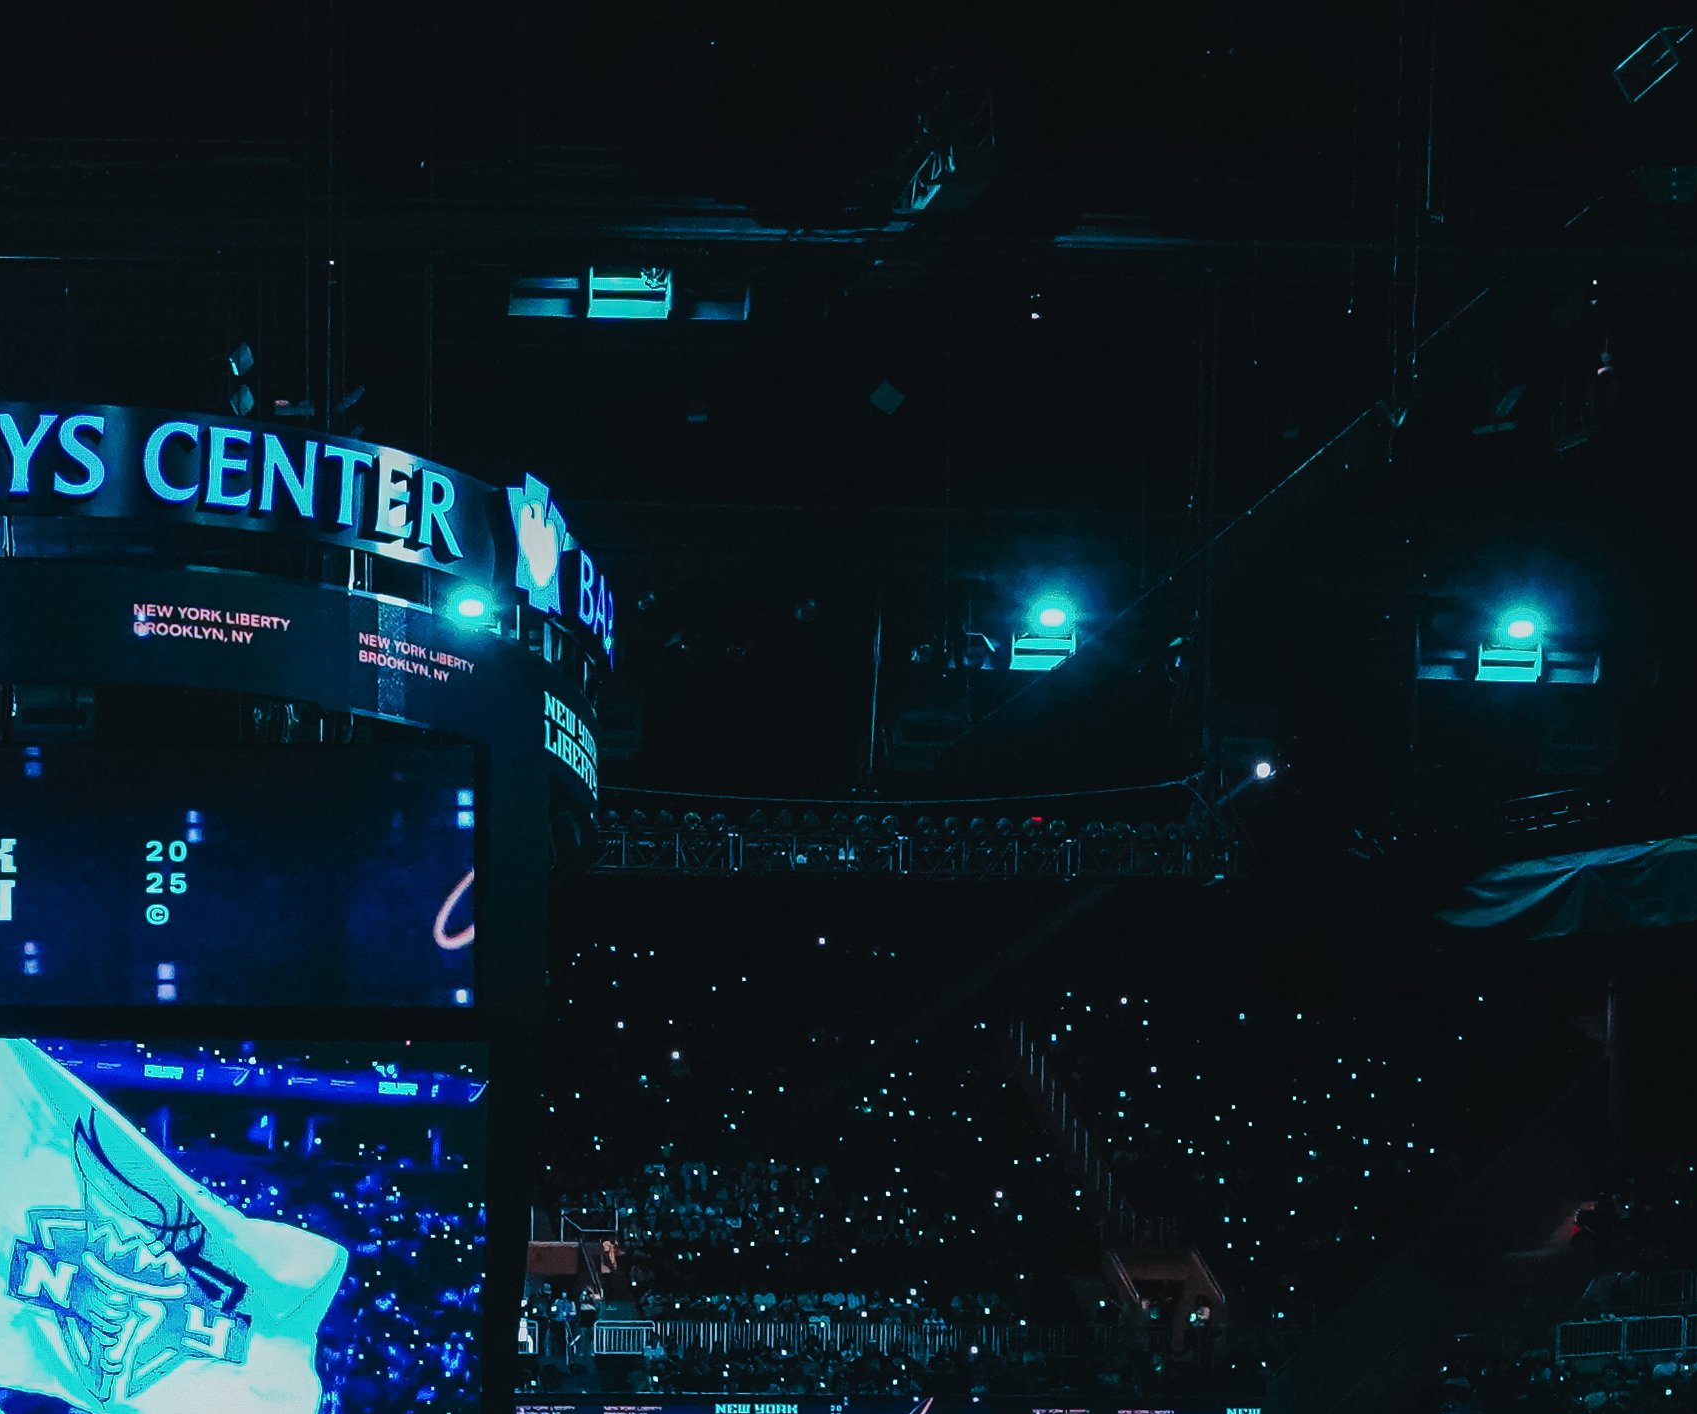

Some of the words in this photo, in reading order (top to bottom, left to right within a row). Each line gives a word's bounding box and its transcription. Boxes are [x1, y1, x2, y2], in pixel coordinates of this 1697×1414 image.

[143, 420, 463, 561] CENTER
[177, 606, 222, 622] YORK
[225, 611, 291, 631] LIBERTY
[231, 630, 253, 644] NY
[359, 632, 391, 650] NEW
[392, 640, 427, 660] YORK
[429, 650, 475, 675] LIBERTY
[433, 668, 450, 683] NY
[544, 690, 576, 738] NEW
[145, 840, 188, 863] 20
[145, 872, 188, 894] 25
[715, 1403, 751, 1414] NEW
[755, 1403, 798, 1414] YORK
